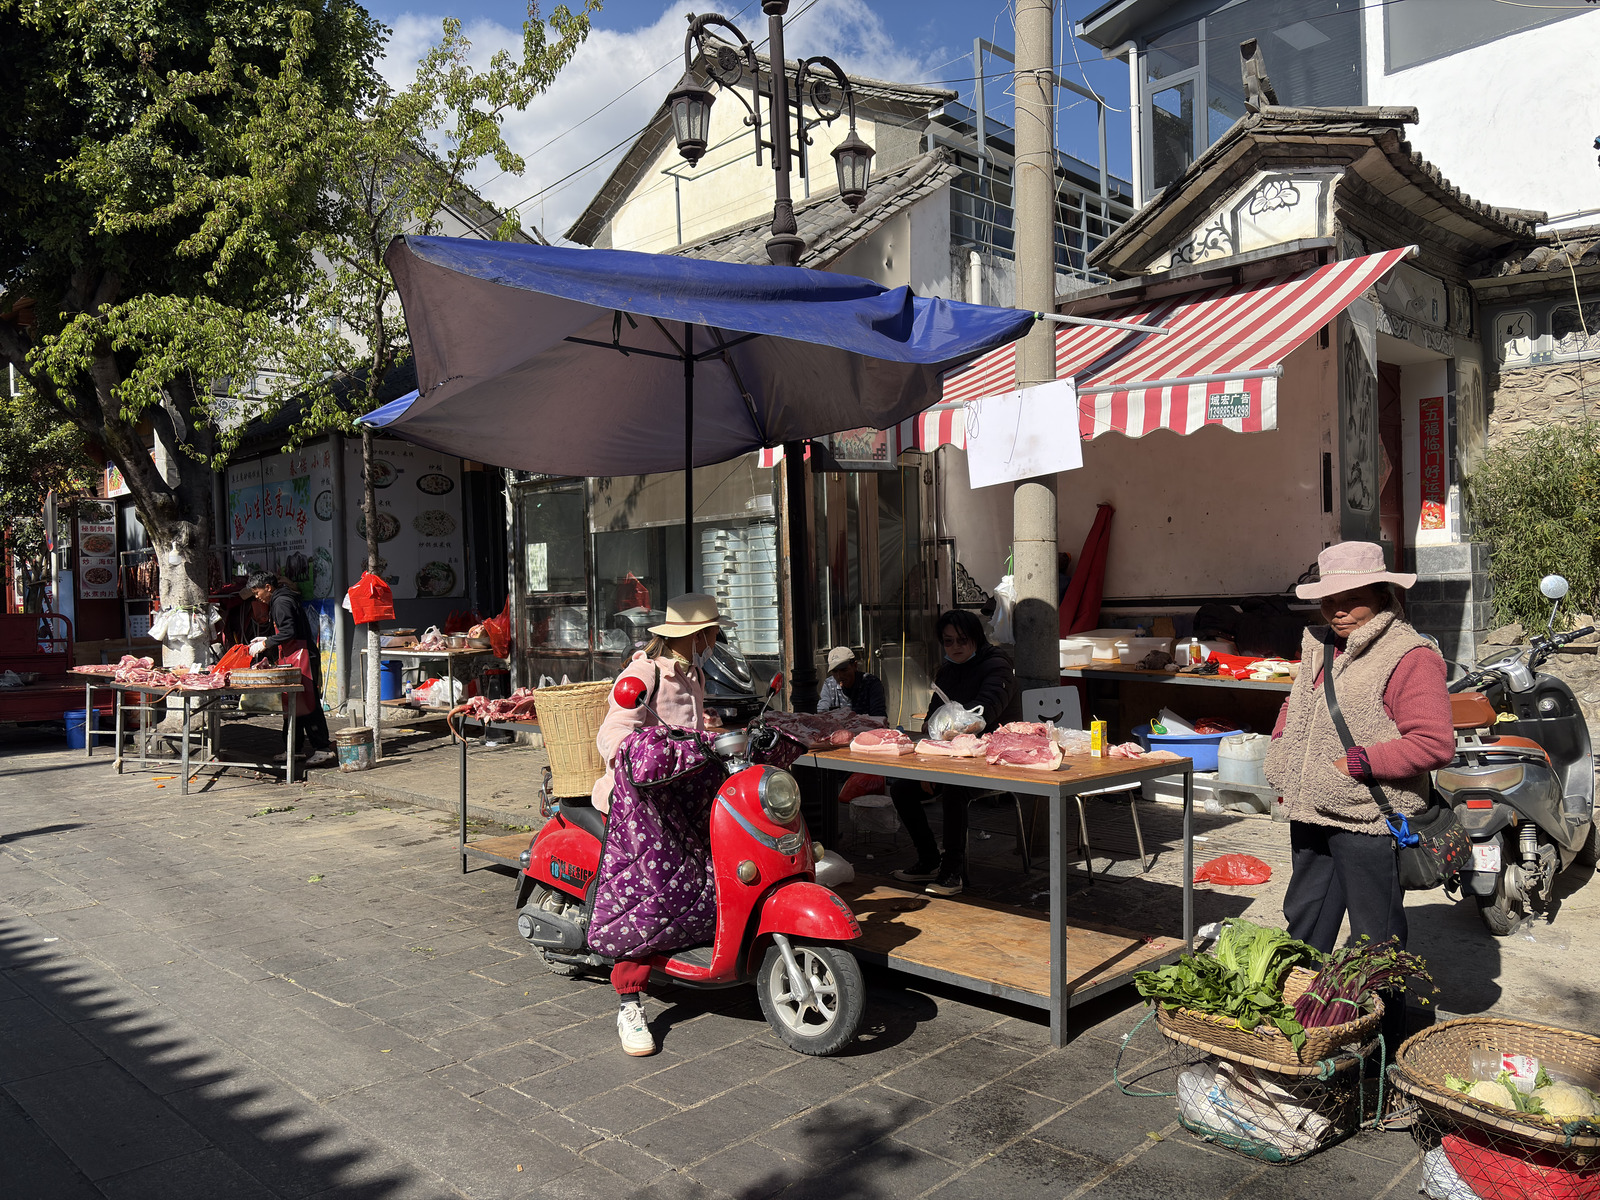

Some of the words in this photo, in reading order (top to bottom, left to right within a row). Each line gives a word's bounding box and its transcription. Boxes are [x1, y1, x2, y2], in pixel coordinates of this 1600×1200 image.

[1423, 407, 1441, 508] 五福临门好运来
[81, 525, 113, 533] 秘制烤肉
[551, 861, 559, 878] 18
